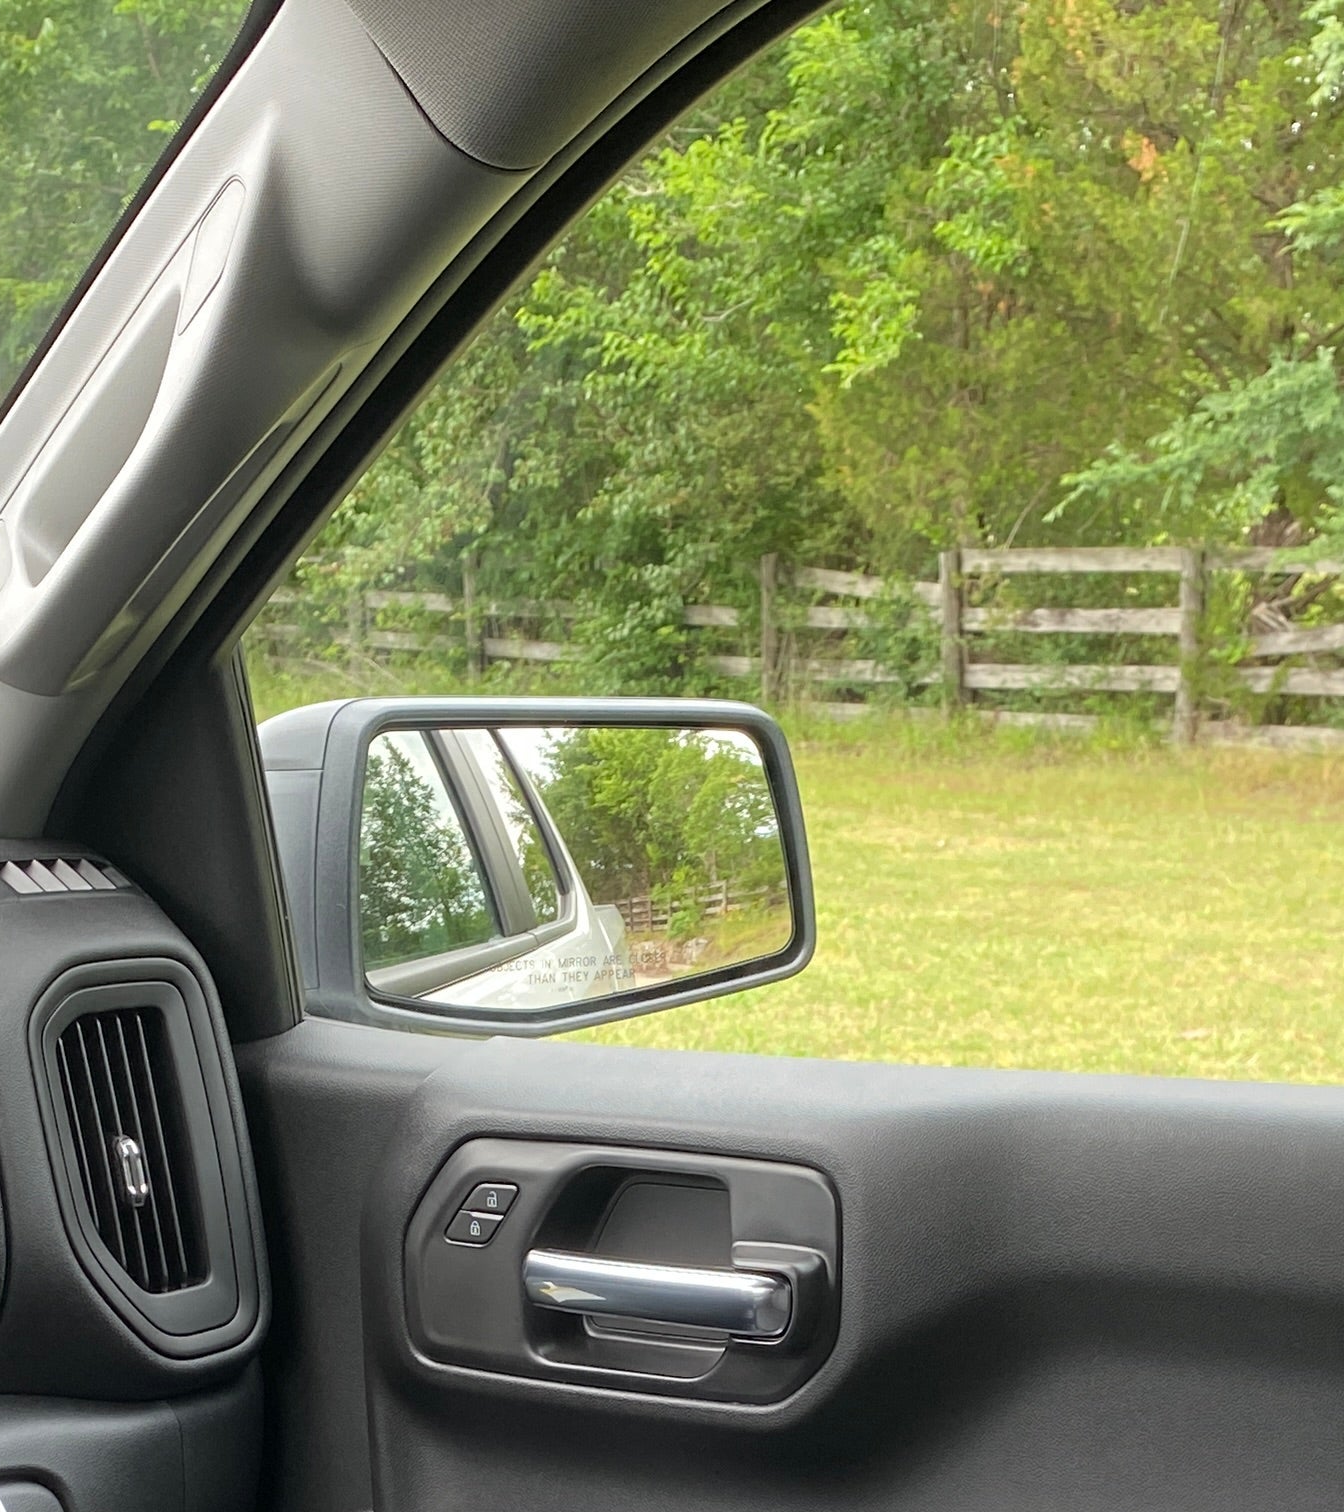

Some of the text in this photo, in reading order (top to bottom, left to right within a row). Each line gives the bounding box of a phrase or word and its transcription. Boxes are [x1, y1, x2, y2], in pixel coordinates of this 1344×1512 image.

[558, 956, 597, 968] MIRROR
[603, 955, 623, 966] ARE
[528, 969, 636, 984] THAN THEY APPEAR
